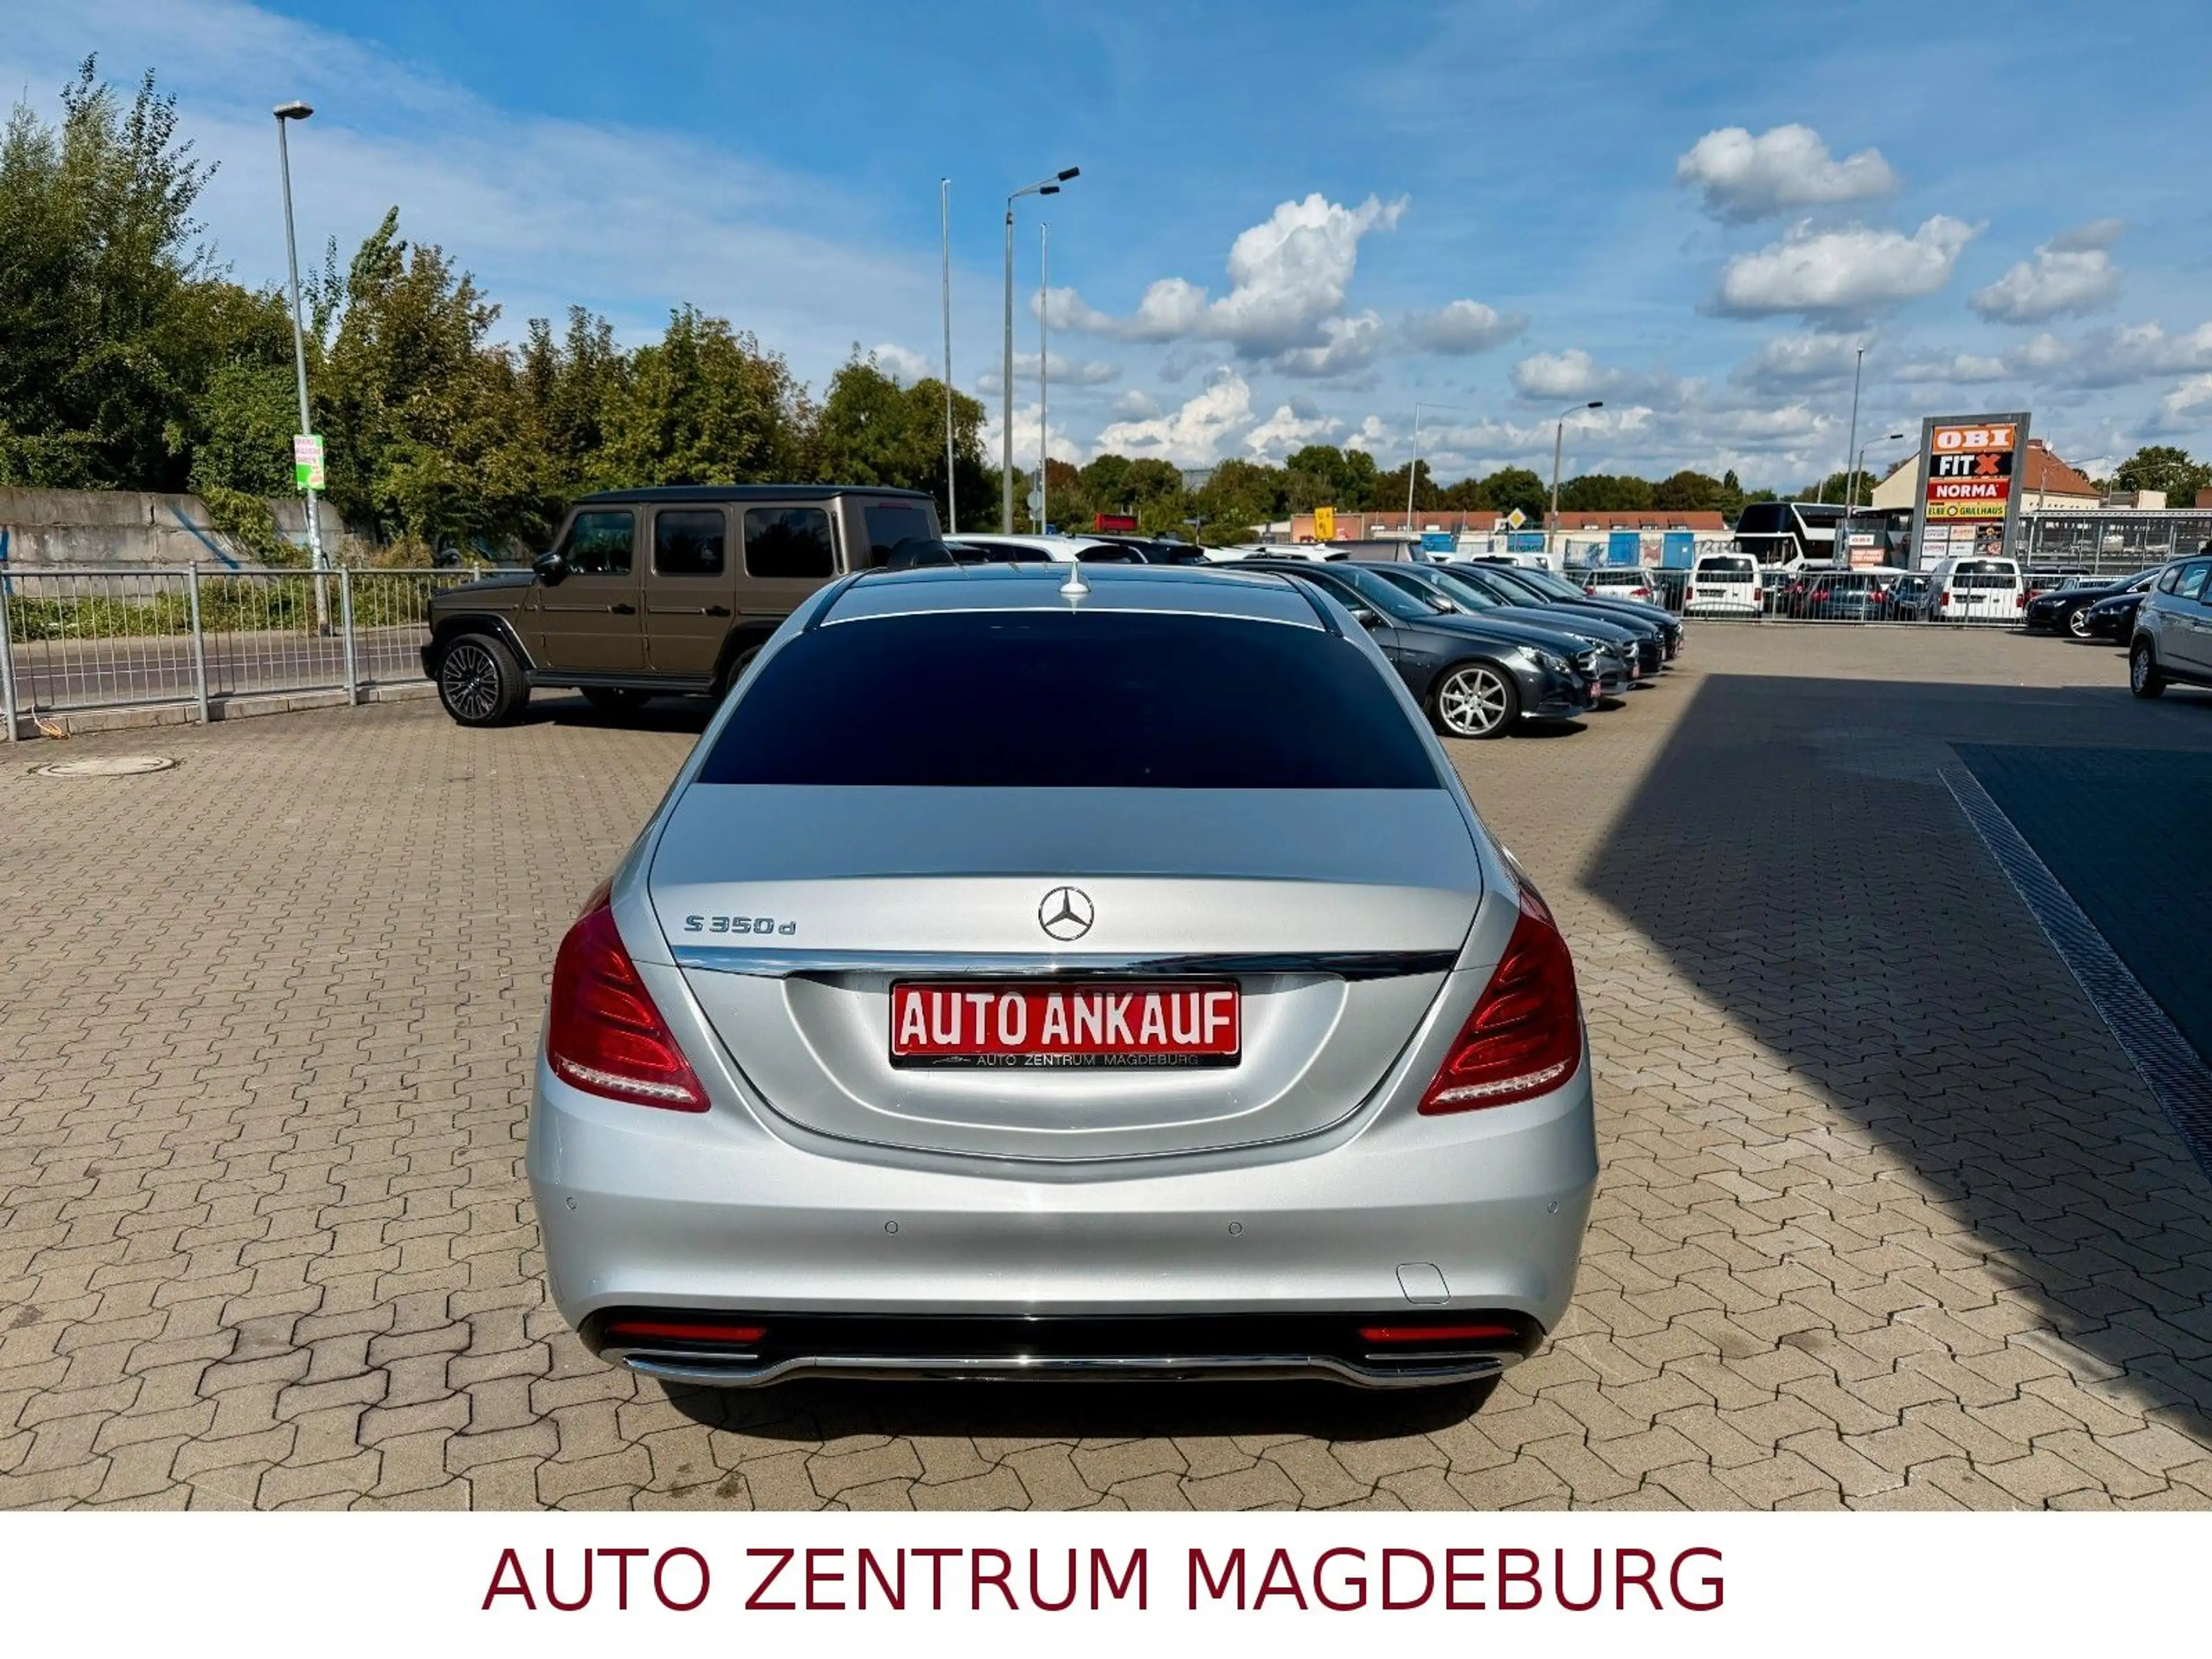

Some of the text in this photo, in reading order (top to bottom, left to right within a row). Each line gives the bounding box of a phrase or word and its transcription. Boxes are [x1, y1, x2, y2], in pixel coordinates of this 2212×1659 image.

[1937, 429, 2011, 449] OBI
[1936, 484, 1998, 498] NORMA
[900, 991, 1232, 1045] AUTO ANKAUF
[976, 1053, 1199, 1066] AUTO ZENTRUM MAGDEBURG
